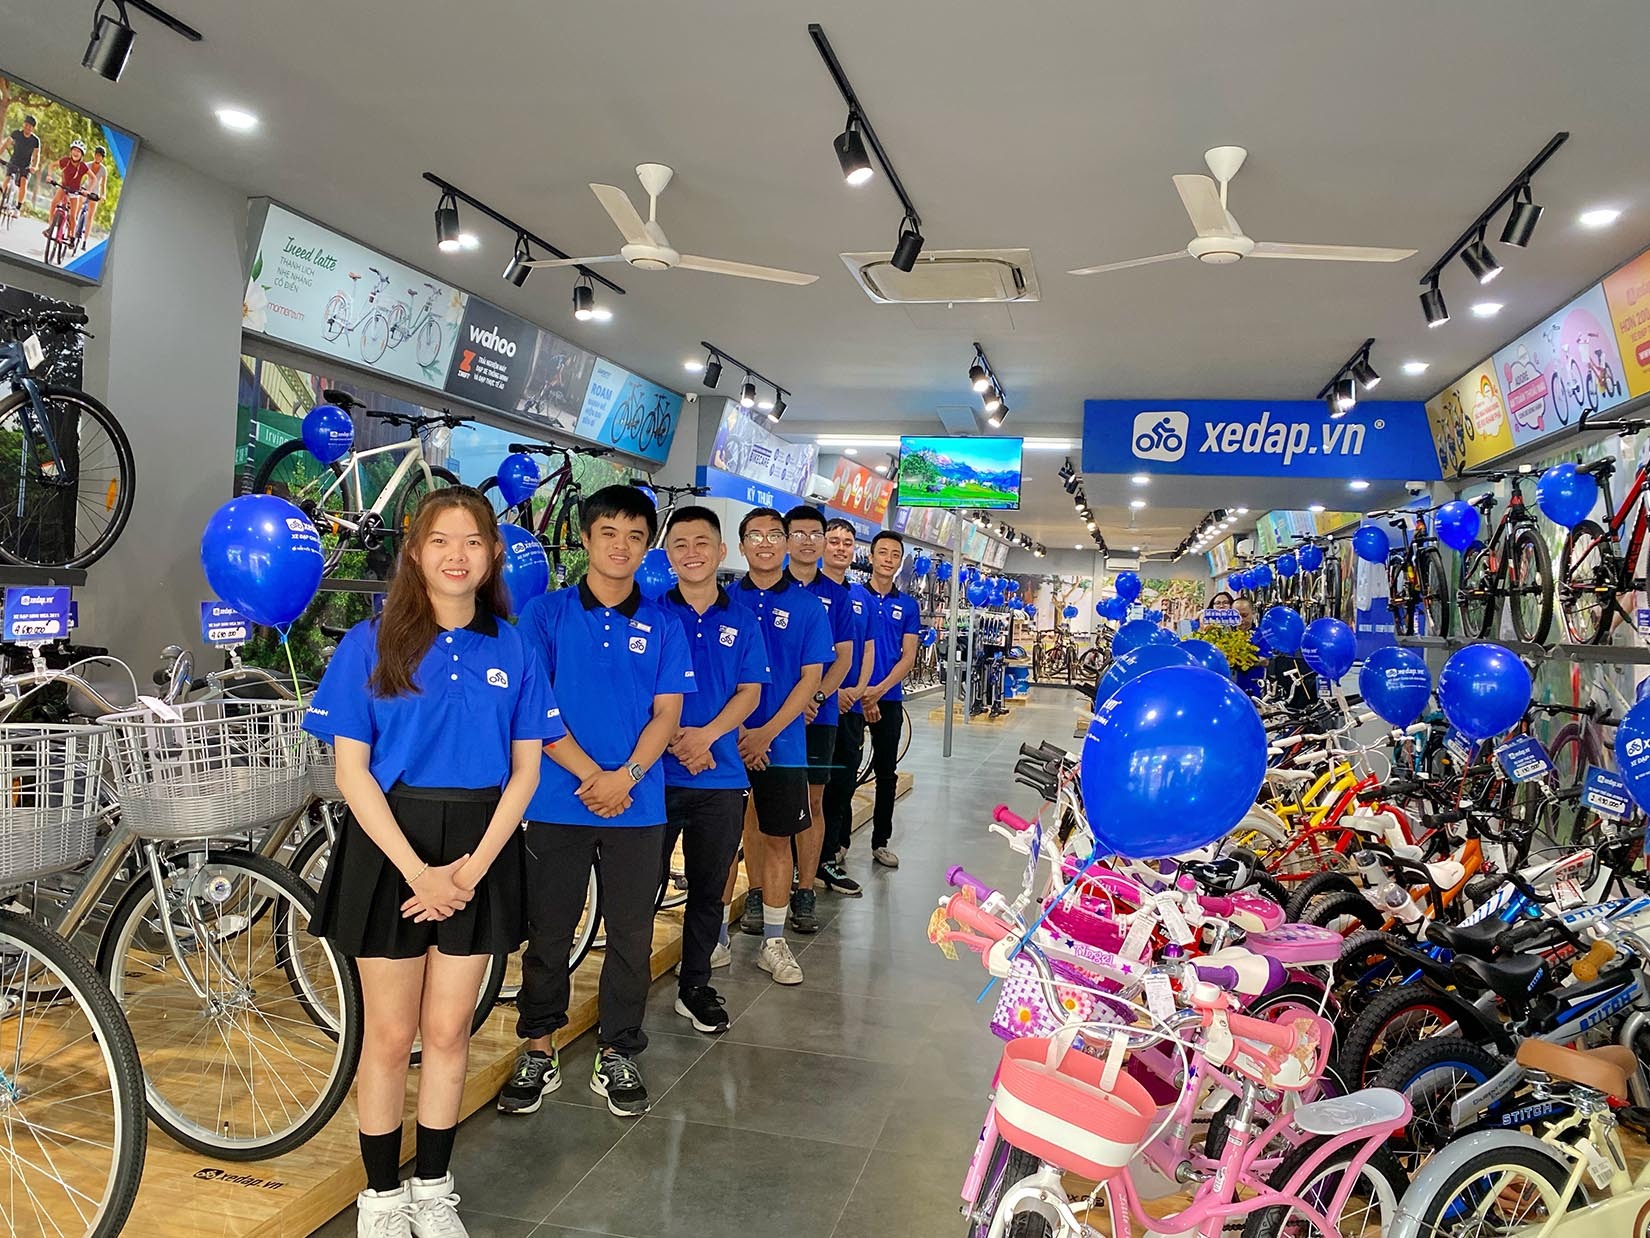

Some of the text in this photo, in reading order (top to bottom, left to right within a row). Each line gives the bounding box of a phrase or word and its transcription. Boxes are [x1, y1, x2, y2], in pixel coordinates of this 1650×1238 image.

[313, 248, 338, 271] latte
[470, 324, 517, 358] wahoo
[1199, 411, 1367, 465] xedap.vn
[1579, 992, 1633, 1032] STITCH
[1502, 1102, 1553, 1126] STITCH
[217, 1174, 285, 1190] xedap.vn
